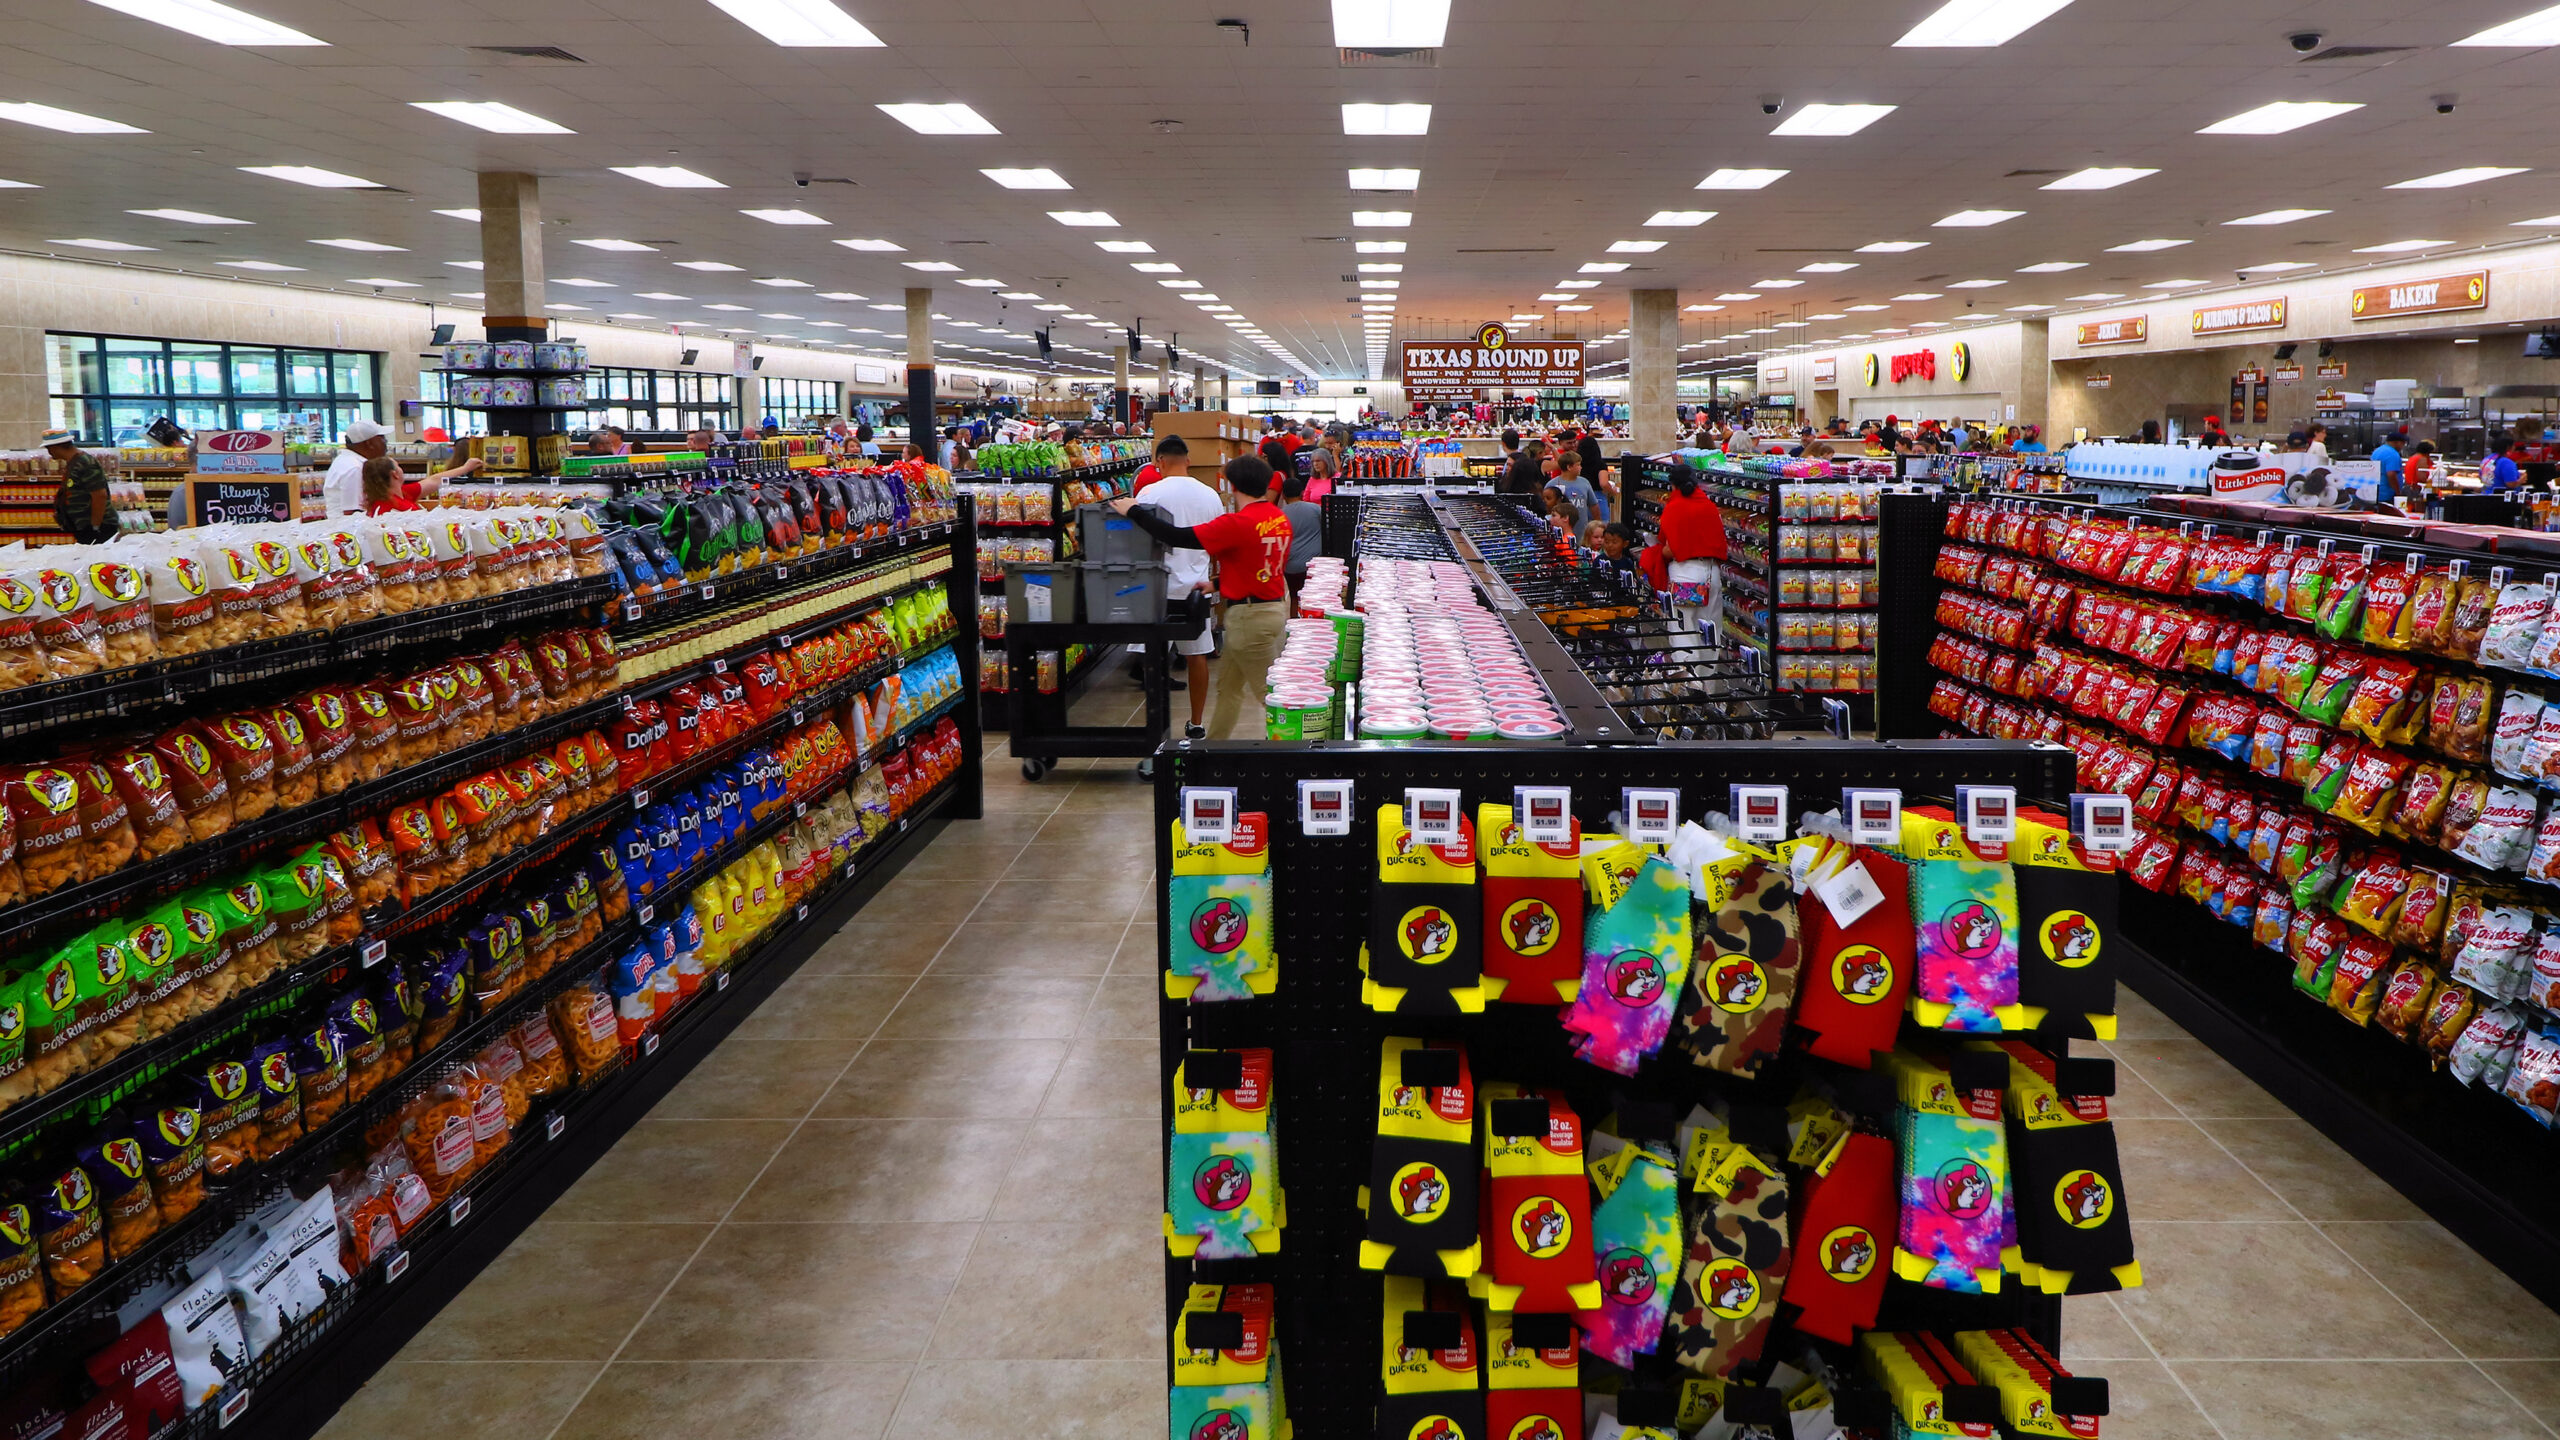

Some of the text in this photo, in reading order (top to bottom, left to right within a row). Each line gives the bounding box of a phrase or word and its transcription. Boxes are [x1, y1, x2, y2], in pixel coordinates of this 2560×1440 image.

[2389, 283, 2440, 309] BAKERY
[2203, 304, 2272, 329] BURRITOS & TACOS
[2097, 322, 2122, 340] JERKY
[1406, 348, 1581, 368] TEXAS ROUND UP
[2242, 373, 2257, 382] TACOS
[2276, 370, 2300, 380] BURRITOS
[2217, 471, 2282, 490] Little Debbie
[219, 484, 270, 506] Always
[206, 499, 226, 525] 5
[2481, 803, 2537, 820] ombos
[1423, 821, 1446, 829] $1.99
[1535, 818, 1558, 826] $1.99
[1641, 819, 1664, 828] $2.99
[1751, 816, 1774, 825] $2.99
[1864, 820, 1887, 828] $2.99
[1980, 818, 2003, 826] $1.99
[1243, 825, 1255, 834] oz.
[2096, 827, 2120, 835] $1.99
[23, 829, 62, 851] PORK
[1232, 834, 1256, 842] Beverage
[1232, 841, 1256, 849] Insulator
[1548, 842, 1572, 850] Insulator
[1445, 850, 1468, 858] Insulator
[236, 933, 263, 952] PORK
[41, 1032, 68, 1054] PORK
[1245, 1078, 1257, 1088] oz.
[1234, 1088, 1258, 1097] Beverage
[1442, 1086, 1465, 1099] 12 oz.
[1234, 1095, 1258, 1103] Insulator
[1440, 1097, 1465, 1107] Beverage
[1440, 1105, 1465, 1114] Insulator
[208, 1118, 237, 1137] PORK
[1549, 1119, 1573, 1131] 12 oz.
[1549, 1130, 1574, 1139] Beverage
[1549, 1138, 1574, 1147] Insulator
[168, 1166, 194, 1186] PORK
[292, 1216, 321, 1240] flock
[62, 1227, 92, 1252] PORK
[252, 1250, 278, 1275] flock
[182, 1287, 215, 1314] flock
[1234, 1347, 1258, 1357] Insulator
